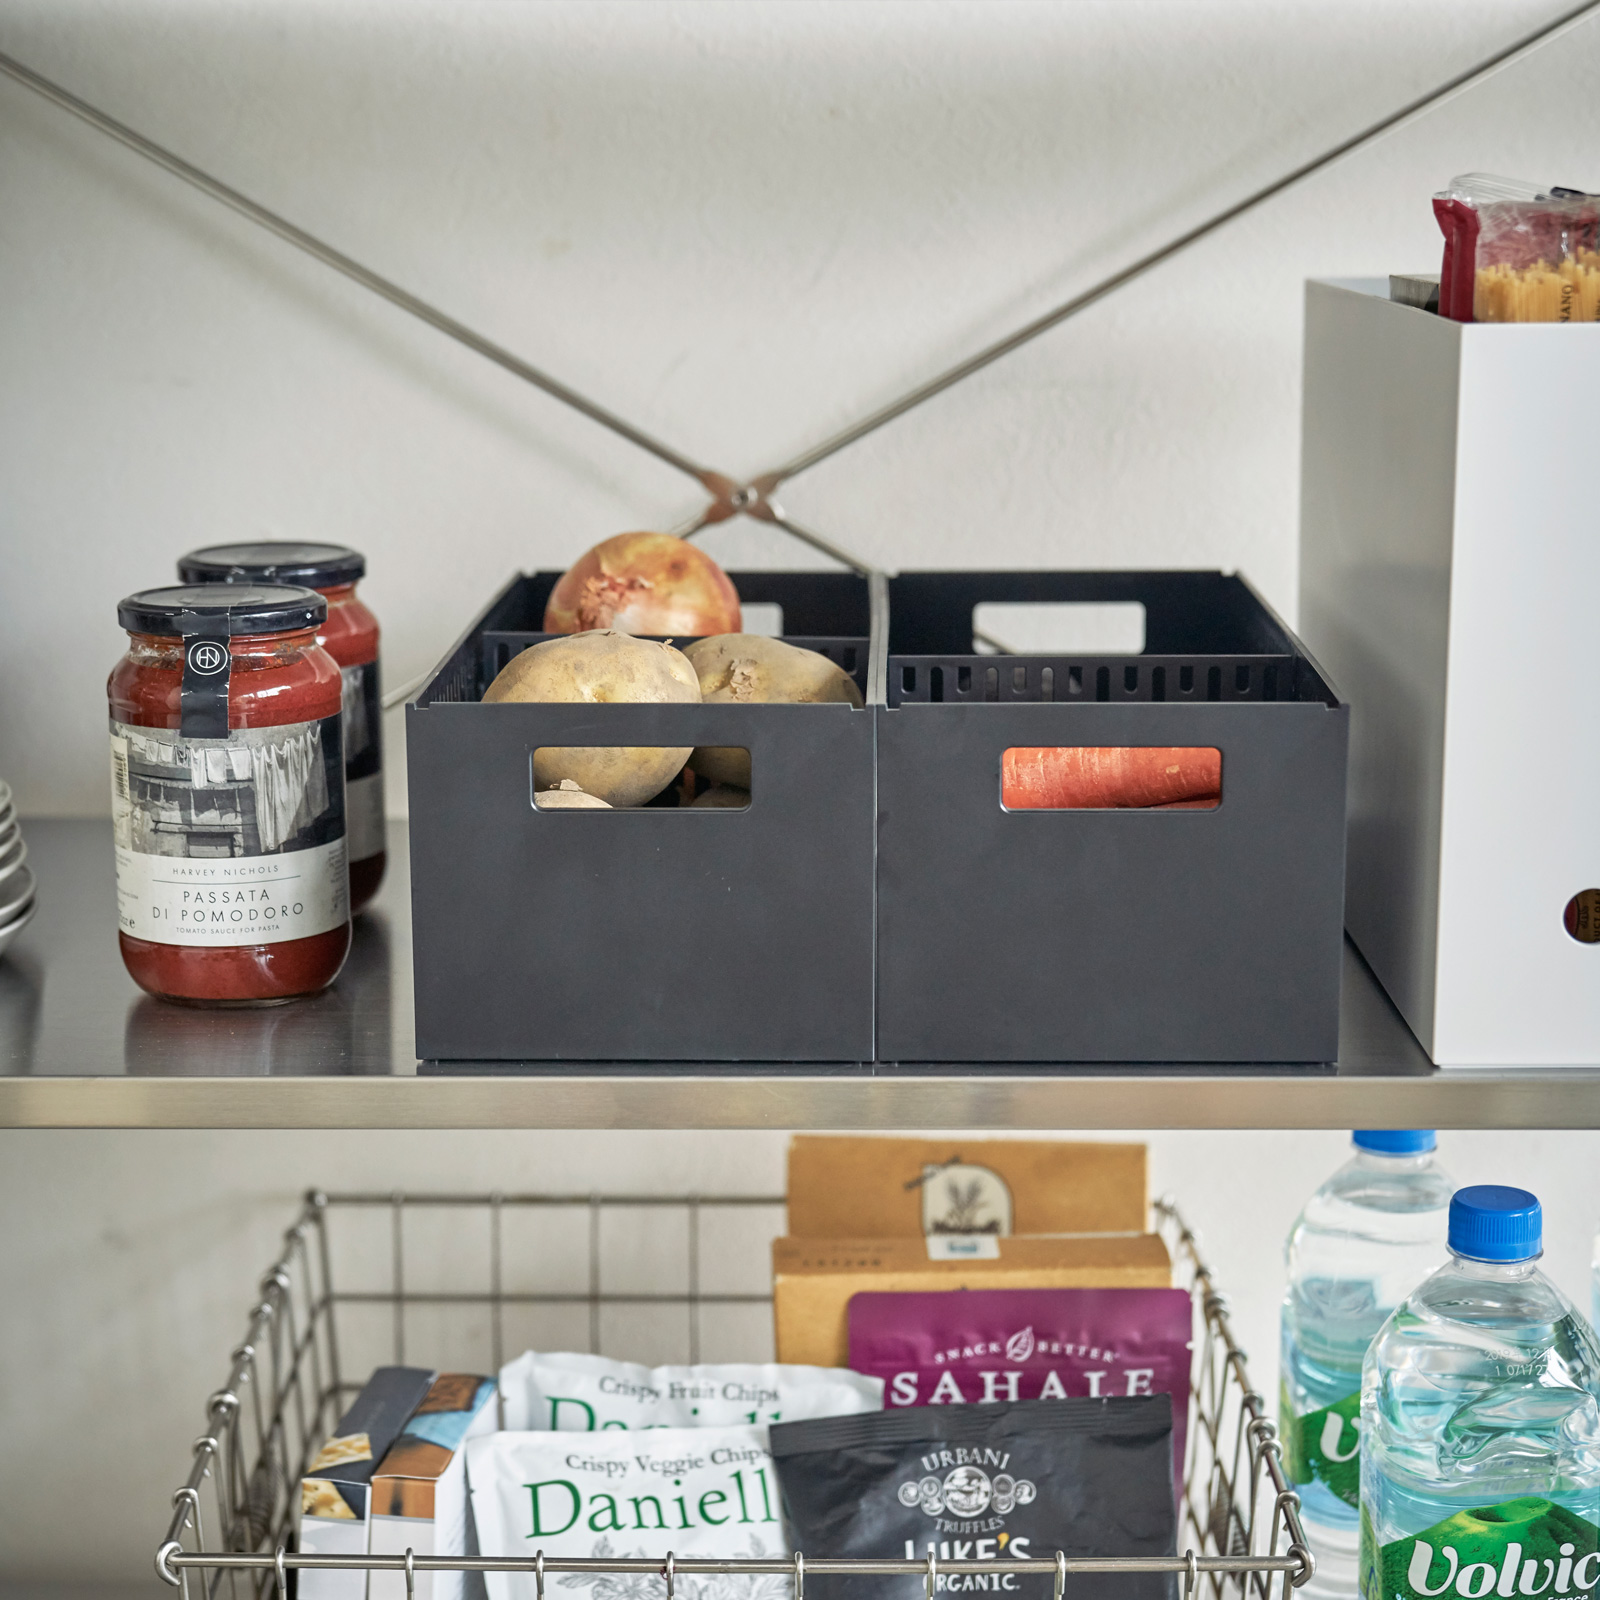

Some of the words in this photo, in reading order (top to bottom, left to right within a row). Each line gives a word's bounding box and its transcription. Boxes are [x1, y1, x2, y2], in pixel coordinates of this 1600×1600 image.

[172, 867, 216, 877] HARVEY
[224, 864, 279, 876] NICHOLS
[183, 889, 270, 904] PASSATA
[152, 906, 168, 920] DI
[181, 902, 304, 922] POMODORO
[176, 927, 207, 935] TOMATO
[210, 926, 236, 935] SAUCE
[240, 925, 255, 934] FOR
[258, 924, 280, 933] PASTA
[934, 1341, 999, 1365] SNACK
[1037, 1340, 1114, 1364] BETTER
[598, 1375, 661, 1404] Crispy
[668, 1381, 715, 1401] Fruit
[721, 1382, 781, 1407] Chips
[890, 1368, 1155, 1405] SAHALE
[565, 1454, 630, 1478] Crispy
[635, 1453, 706, 1478] Veggie
[710, 1446, 772, 1466] Chips
[921, 1447, 1011, 1473] URBANI
[934, 1515, 1006, 1534] TRUFFLES
[1407, 1539, 1600, 1598] Volvic
[922, 1573, 1016, 1593] RGANIC
